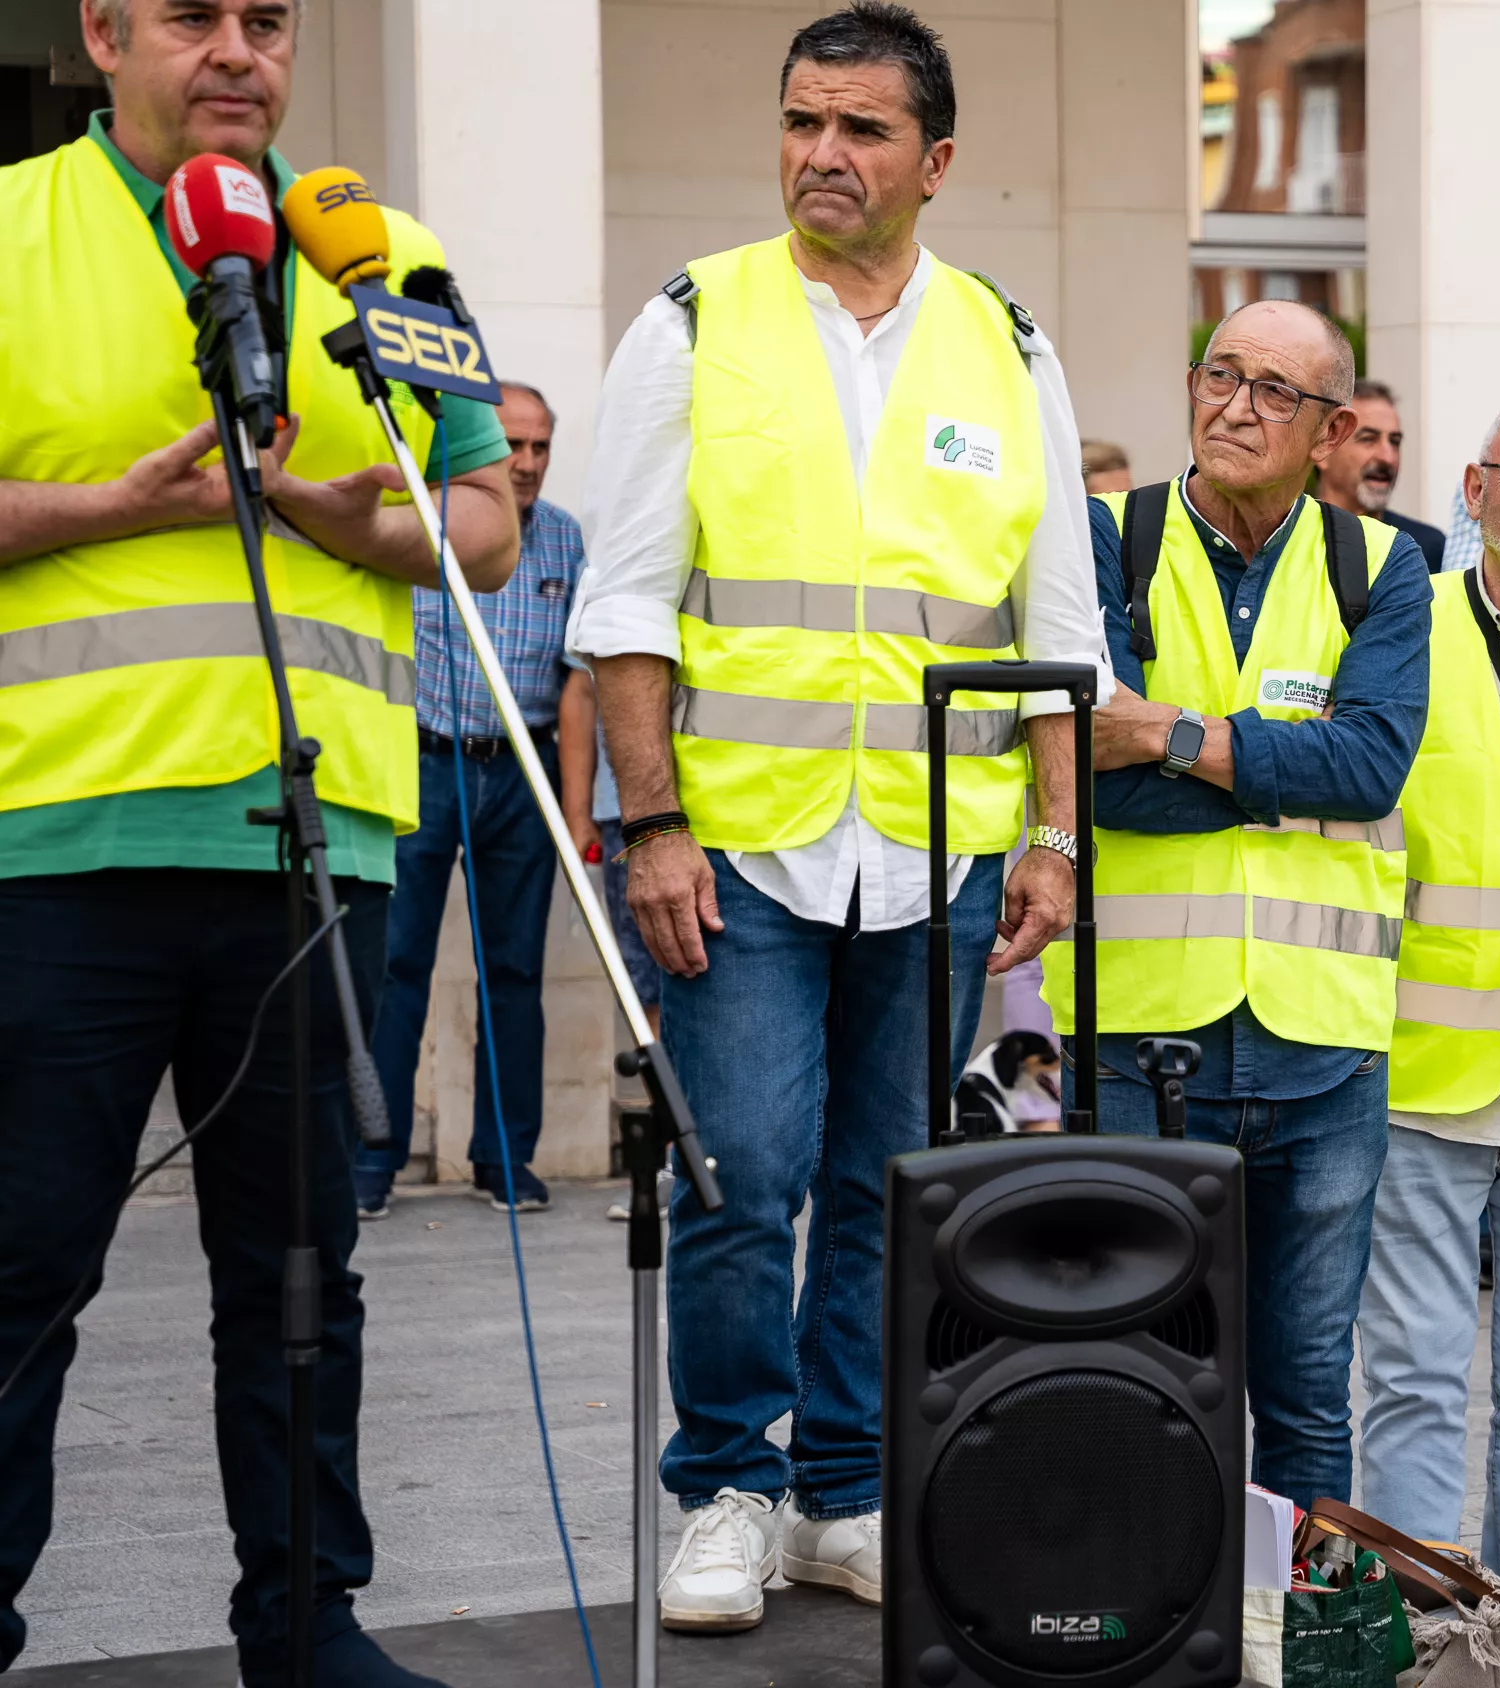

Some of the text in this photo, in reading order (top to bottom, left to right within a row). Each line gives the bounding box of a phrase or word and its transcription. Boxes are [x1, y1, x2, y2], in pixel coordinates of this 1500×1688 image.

[366, 307, 491, 385] SER
[969, 444, 994, 456] Lucena
[975, 460, 994, 472] Social
[1031, 1613, 1100, 1634] ibiza
